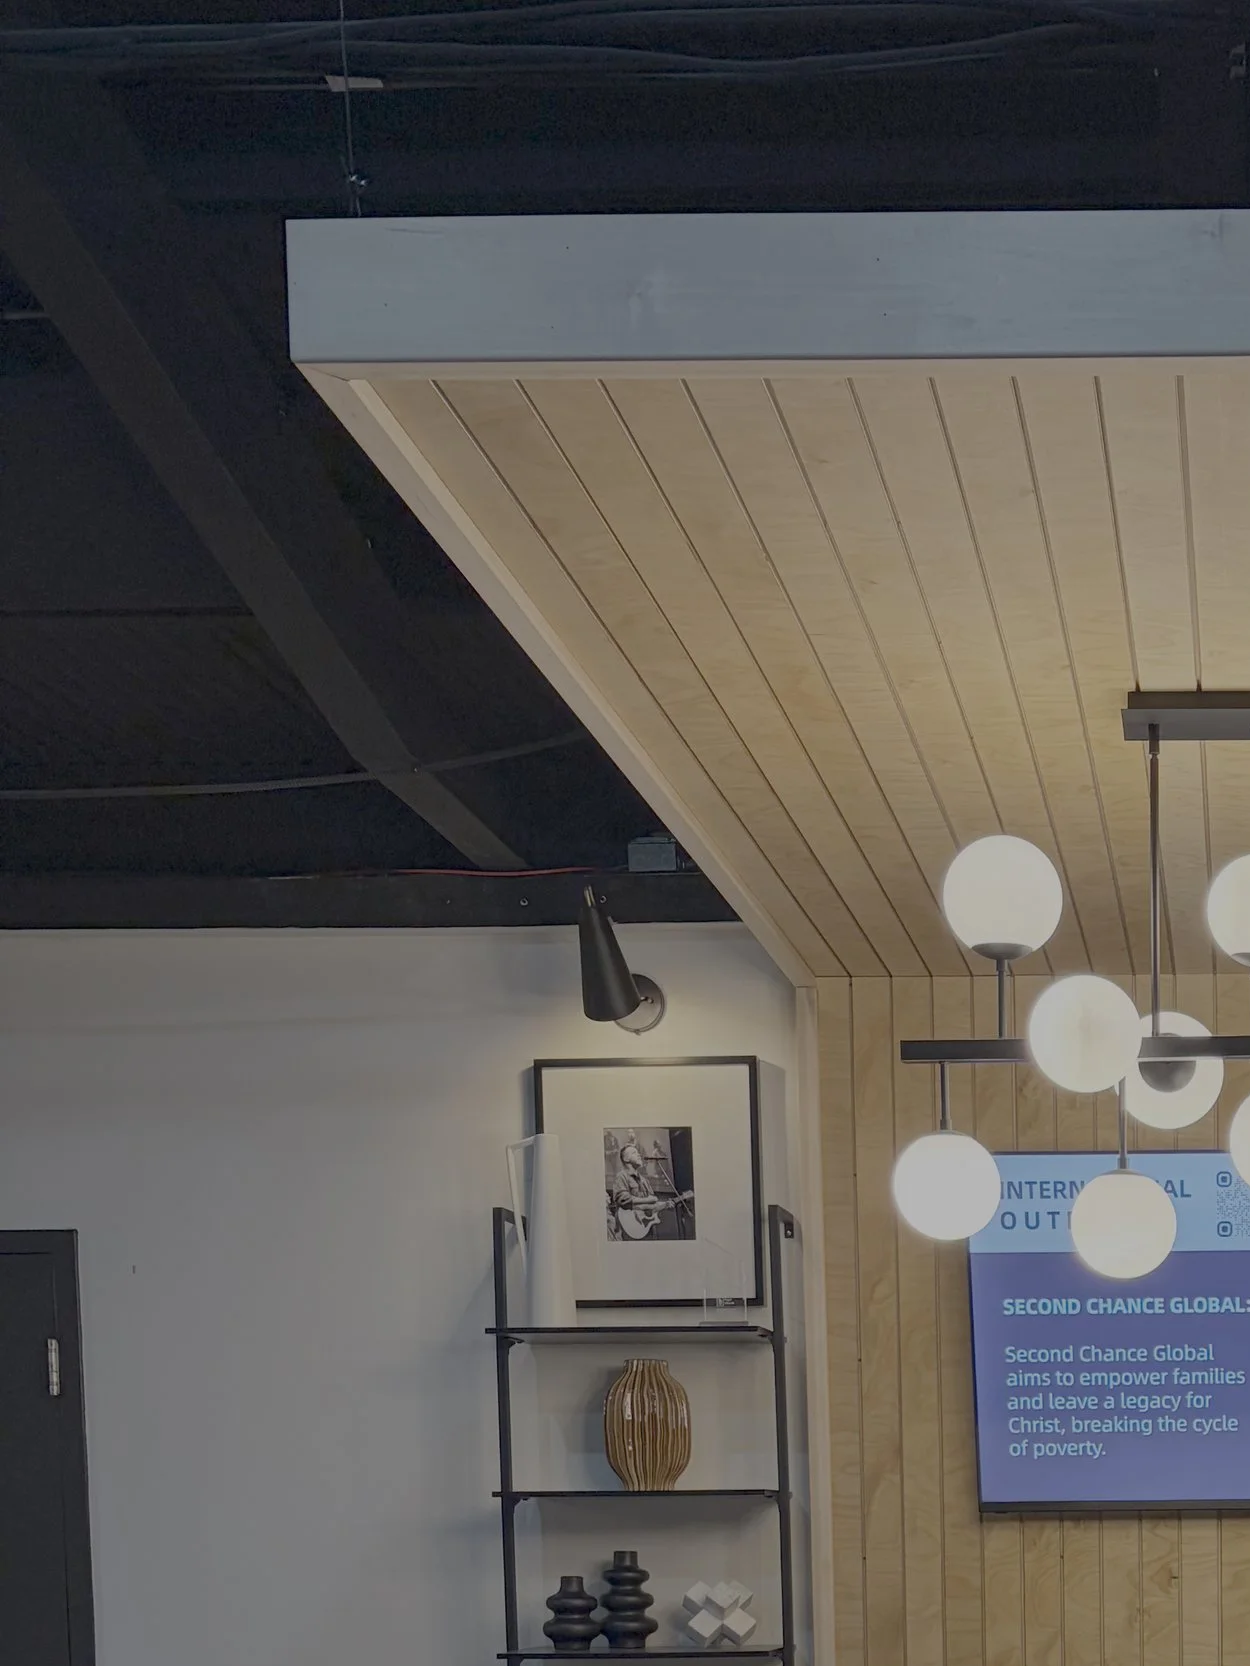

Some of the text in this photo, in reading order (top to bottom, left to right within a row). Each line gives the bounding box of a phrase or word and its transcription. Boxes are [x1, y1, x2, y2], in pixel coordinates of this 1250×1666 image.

[1003, 1298, 1081, 1315] SECOND
[1086, 1297, 1165, 1315] CHANCE
[1004, 1343, 1215, 1363] Second Chance Global
[1006, 1367, 1246, 1389] aims to empower families
[1007, 1391, 1213, 1413] and leave a legacy for
[1008, 1414, 1239, 1436] Christ, breaking the cycle
[1009, 1439, 1107, 1460] of poverty.
